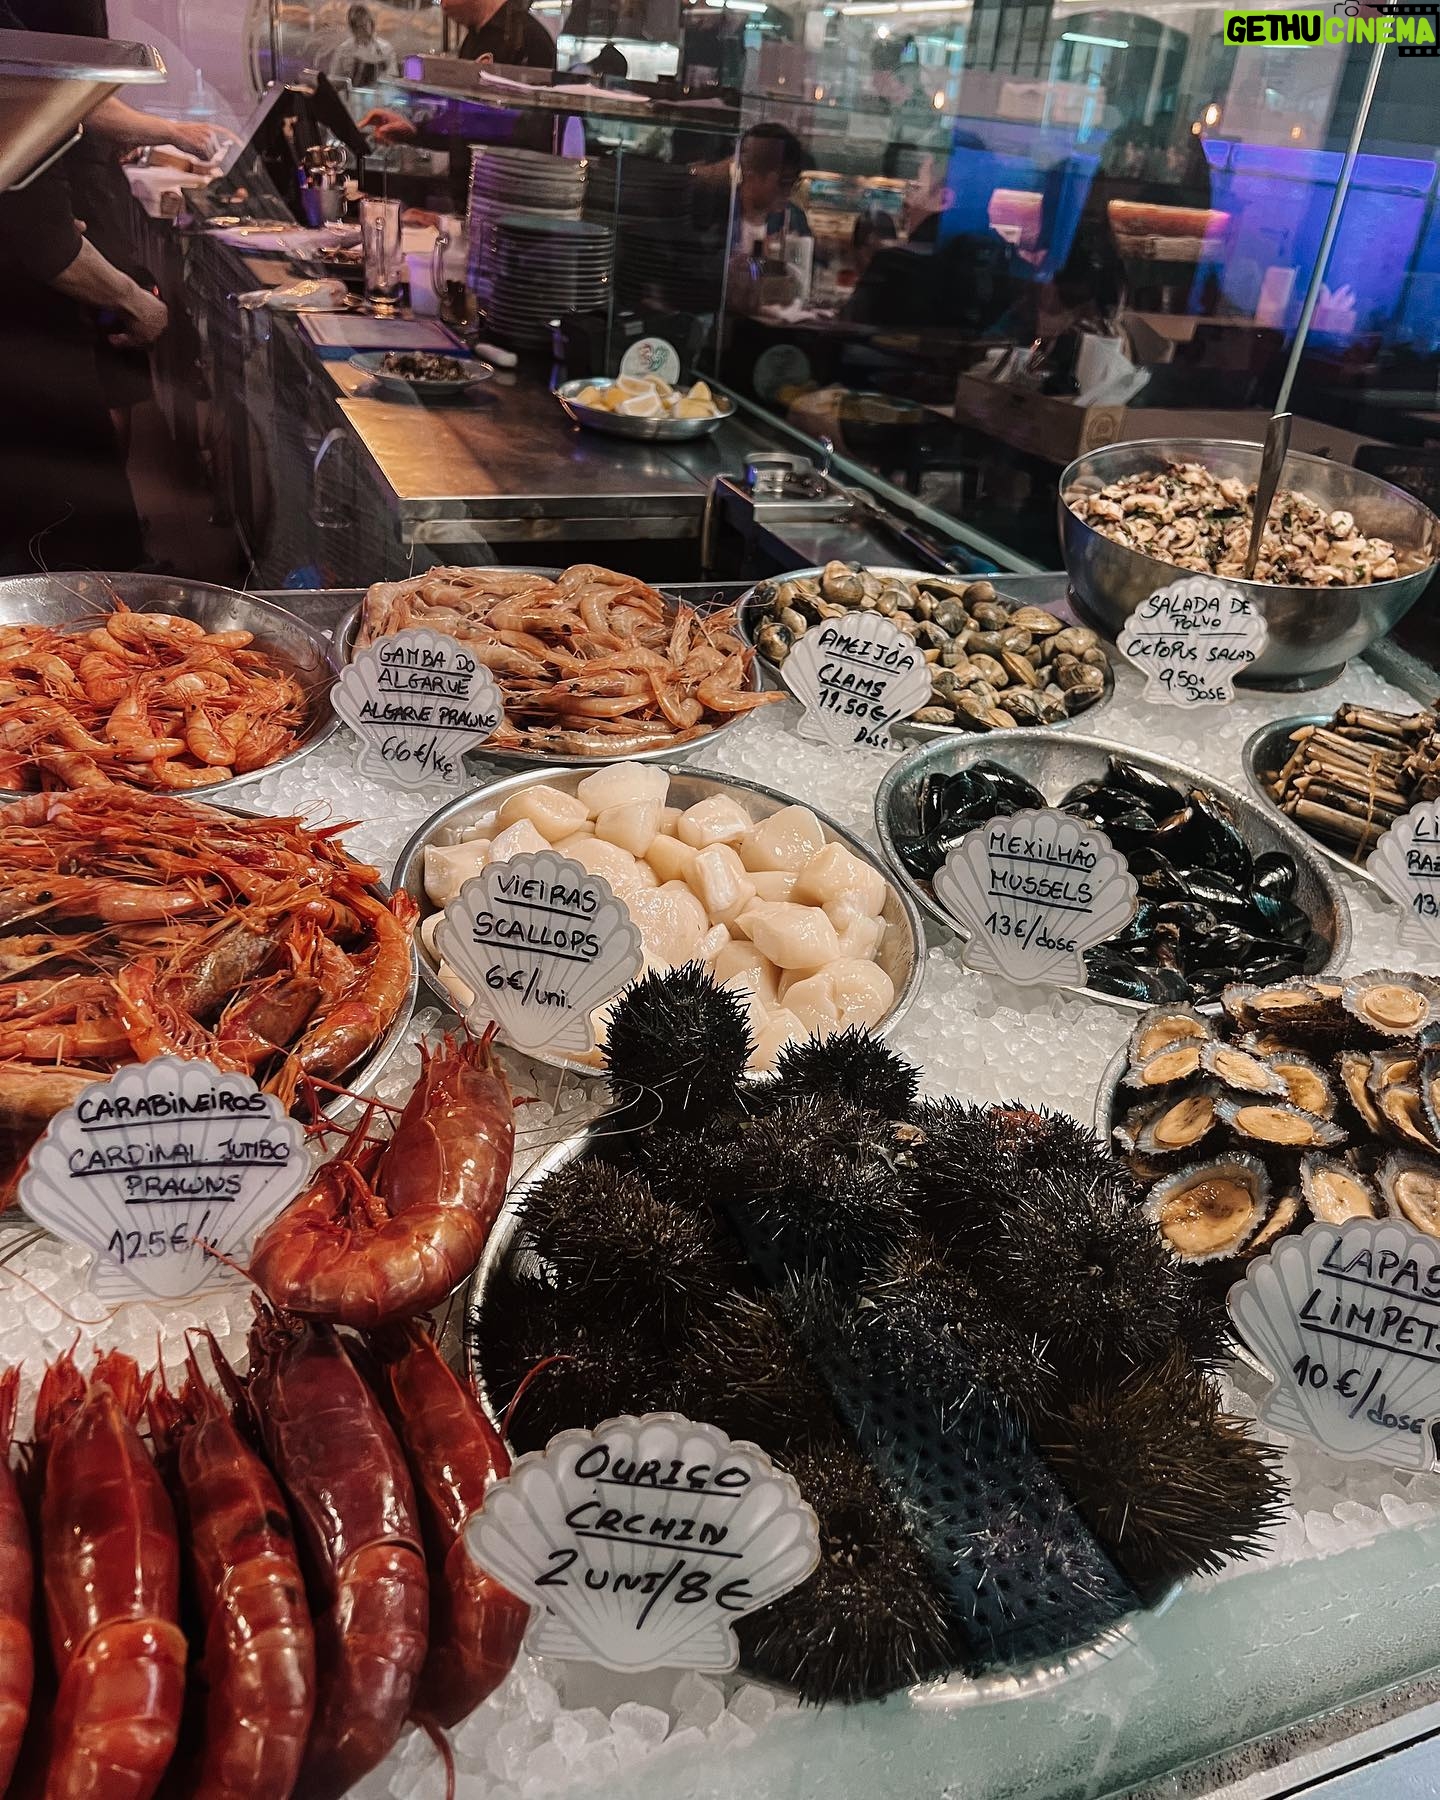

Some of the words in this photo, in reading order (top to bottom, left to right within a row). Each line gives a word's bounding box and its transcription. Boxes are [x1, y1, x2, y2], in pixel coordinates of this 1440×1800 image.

[1141, 594, 1220, 618] SALADA
[1229, 598, 1251, 615] DE
[1169, 614, 1222, 630] POLVO
[379, 643, 446, 668] GAMBA
[455, 654, 476, 673] DO
[1206, 646, 1256, 662] SALAD
[378, 668, 471, 695] ALGARVE
[818, 663, 887, 697] CLAMS
[1186, 687, 1227, 701] DOSE
[359, 700, 433, 722] ALGARVE
[439, 707, 497, 728] PRAWNS
[990, 868, 1093, 903] MUSSELS
[1413, 892, 1440, 917] 13,
[473, 911, 599, 957] SCALLOPS
[125, 1174, 242, 1197] PRAWNS
[1322, 1236, 1440, 1298] LAPAS
[534, 1549, 579, 1586] 2
